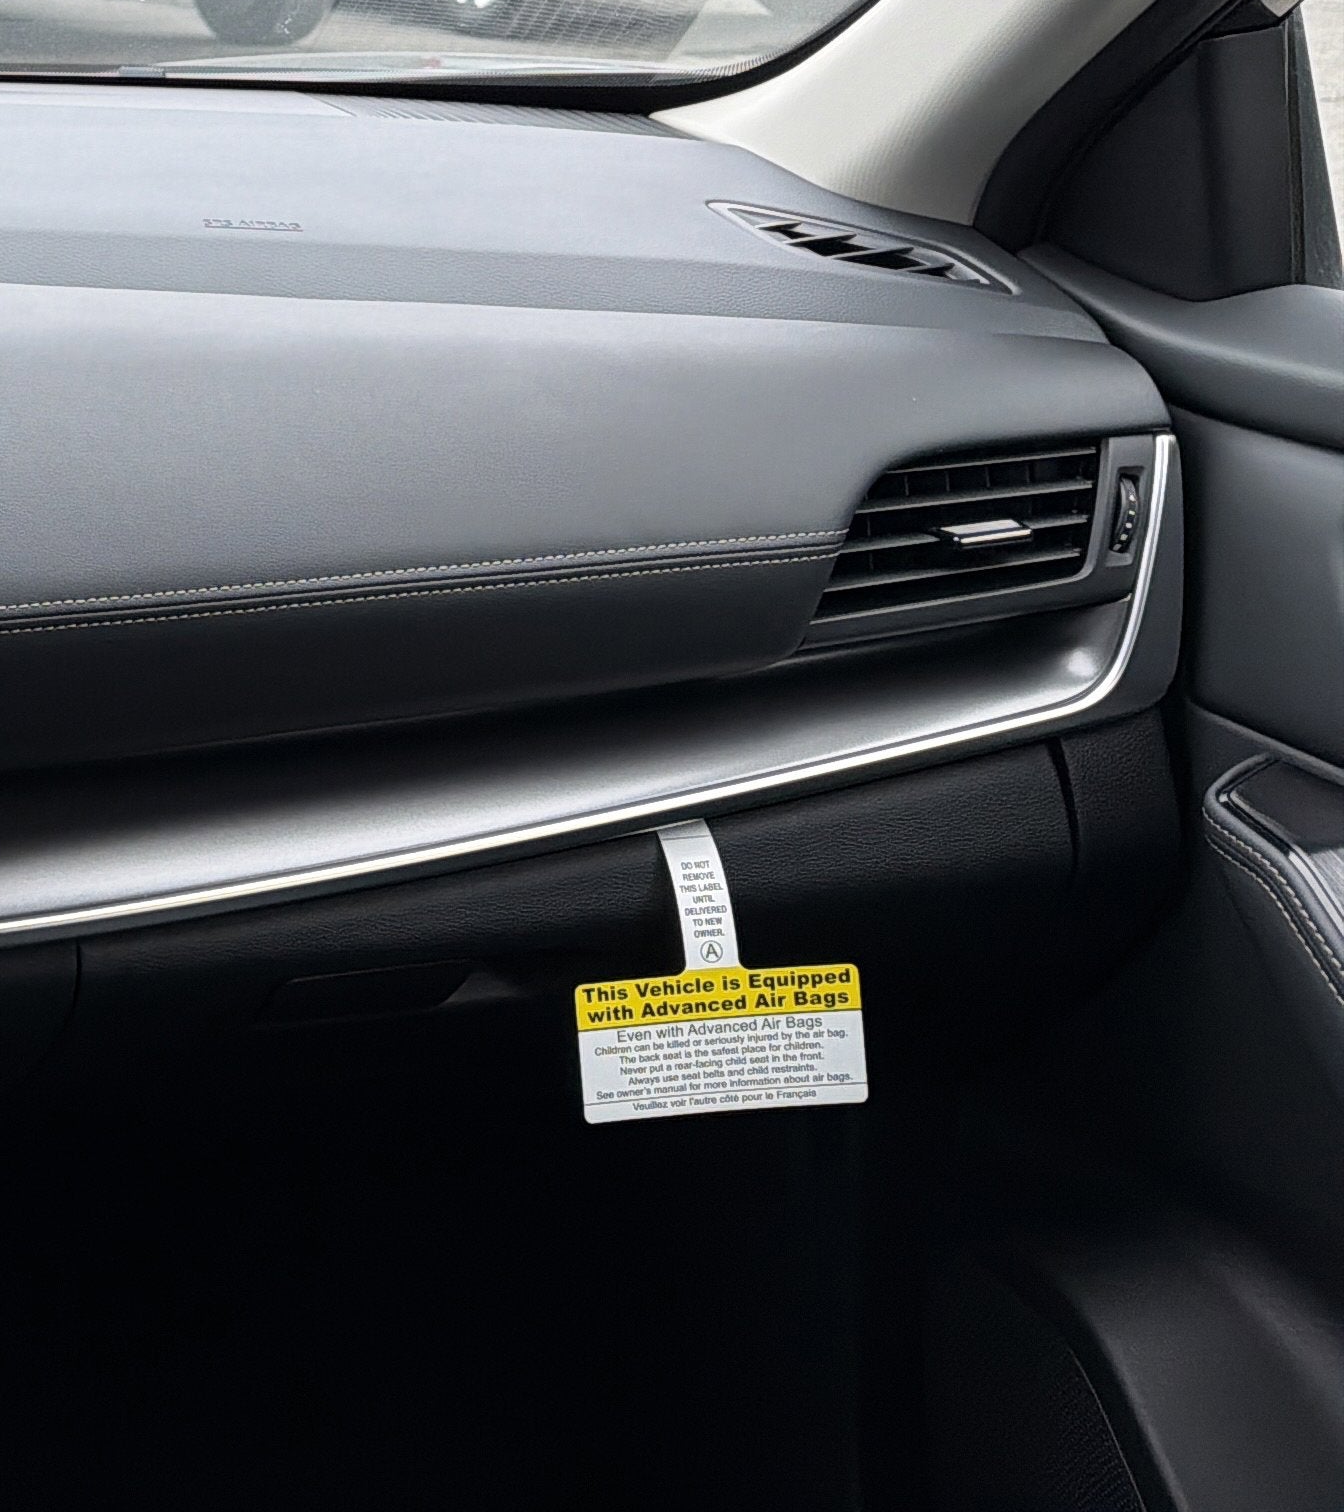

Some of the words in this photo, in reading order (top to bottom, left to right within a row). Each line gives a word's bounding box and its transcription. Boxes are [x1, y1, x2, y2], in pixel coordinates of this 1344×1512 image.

[681, 861, 693, 871] DO
[693, 860, 710, 869] NOT
[682, 871, 715, 881] REMOVE
[679, 884, 697, 893] THIS
[698, 882, 724, 892] LABEL
[692, 894, 716, 904] UNTIL
[684, 904, 727, 916] DELIVERED
[692, 918, 703, 927] TO
[704, 917, 723, 926] NEW
[693, 928, 725, 938] OWNER.
[581, 986, 629, 1004] This
[634, 978, 715, 998] Vehicle
[721, 976, 741, 991] is
[748, 968, 851, 991] Equipped
[587, 1005, 634, 1023] with
[641, 995, 747, 1018] Advanced
[754, 993, 787, 1009] Air
[793, 991, 849, 1008] Bags
[617, 1030, 652, 1043] Even
[655, 1025, 684, 1039] with
[687, 1019, 757, 1036] Advanced
[761, 1017, 782, 1031] Air
[785, 1016, 823, 1030] Bags
[594, 1045, 632, 1057] Children
[633, 1044, 651, 1053] can
[652, 1041, 665, 1051] be
[666, 1039, 691, 1049] killed
[692, 1038, 702, 1047] or
[704, 1033, 746, 1046] seriously
[747, 1032, 779, 1044] injured
[781, 1030, 793, 1041] by
[795, 1030, 810, 1040] the
[812, 1029, 825, 1039] air
[827, 1029, 848, 1039] bag.
[619, 1055, 636, 1065] The
[638, 1052, 660, 1063] back
[662, 1051, 682, 1061] seat
[684, 1050, 692, 1059] is
[694, 1047, 709, 1057] the
[711, 1045, 739, 1056] safest
[741, 1044, 766, 1054] place
[768, 1043, 782, 1052] for
[783, 1040, 824, 1051] children.
[619, 1065, 648, 1076] Never
[649, 1064, 664, 1074] put
[666, 1064, 673, 1072] a
[674, 1059, 723, 1071] rear-facing
[725, 1056, 747, 1066] child
[749, 1054, 770, 1065] seat
[771, 1054, 780, 1063] in
[782, 1053, 798, 1062] the
[799, 1051, 825, 1061] front.
[628, 1076, 660, 1086] Always
[662, 1074, 679, 1083] use
[681, 1071, 701, 1081] seat
[702, 1069, 725, 1079] belts
[727, 1067, 745, 1077] and
[746, 1065, 769, 1076] child
[771, 1063, 818, 1074] restraints.
[596, 1090, 615, 1101] See
[616, 1087, 652, 1098] owner's
[653, 1083, 687, 1094] manual
[689, 1081, 701, 1091] for
[703, 1080, 727, 1089] more
[729, 1077, 781, 1088] information
[783, 1074, 810, 1084] about
[812, 1073, 825, 1082] air
[826, 1072, 853, 1082] bags.
